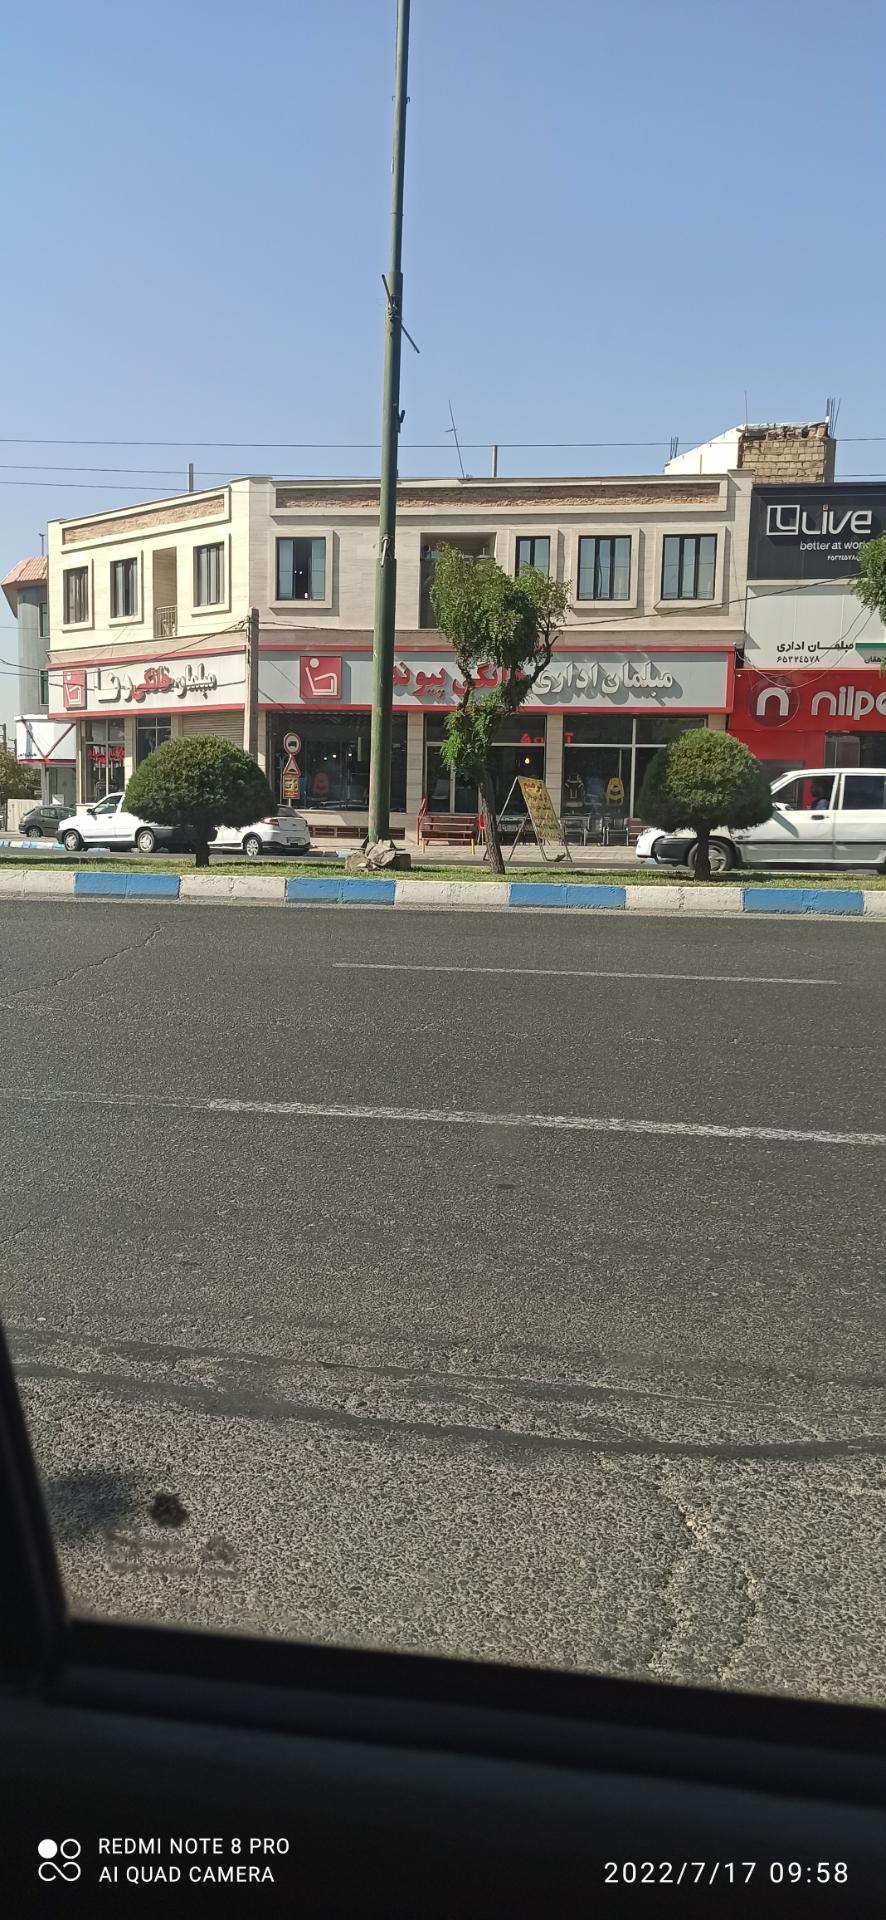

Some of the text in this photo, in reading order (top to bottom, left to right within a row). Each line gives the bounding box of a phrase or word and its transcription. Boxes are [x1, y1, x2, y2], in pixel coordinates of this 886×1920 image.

[800, 541, 831, 551] better
[831, 542, 842, 551] at
[776, 641, 854, 653] مبلمان اداری
[532, 661, 600, 695] اداری
[602, 660, 673, 697] مبلمان
